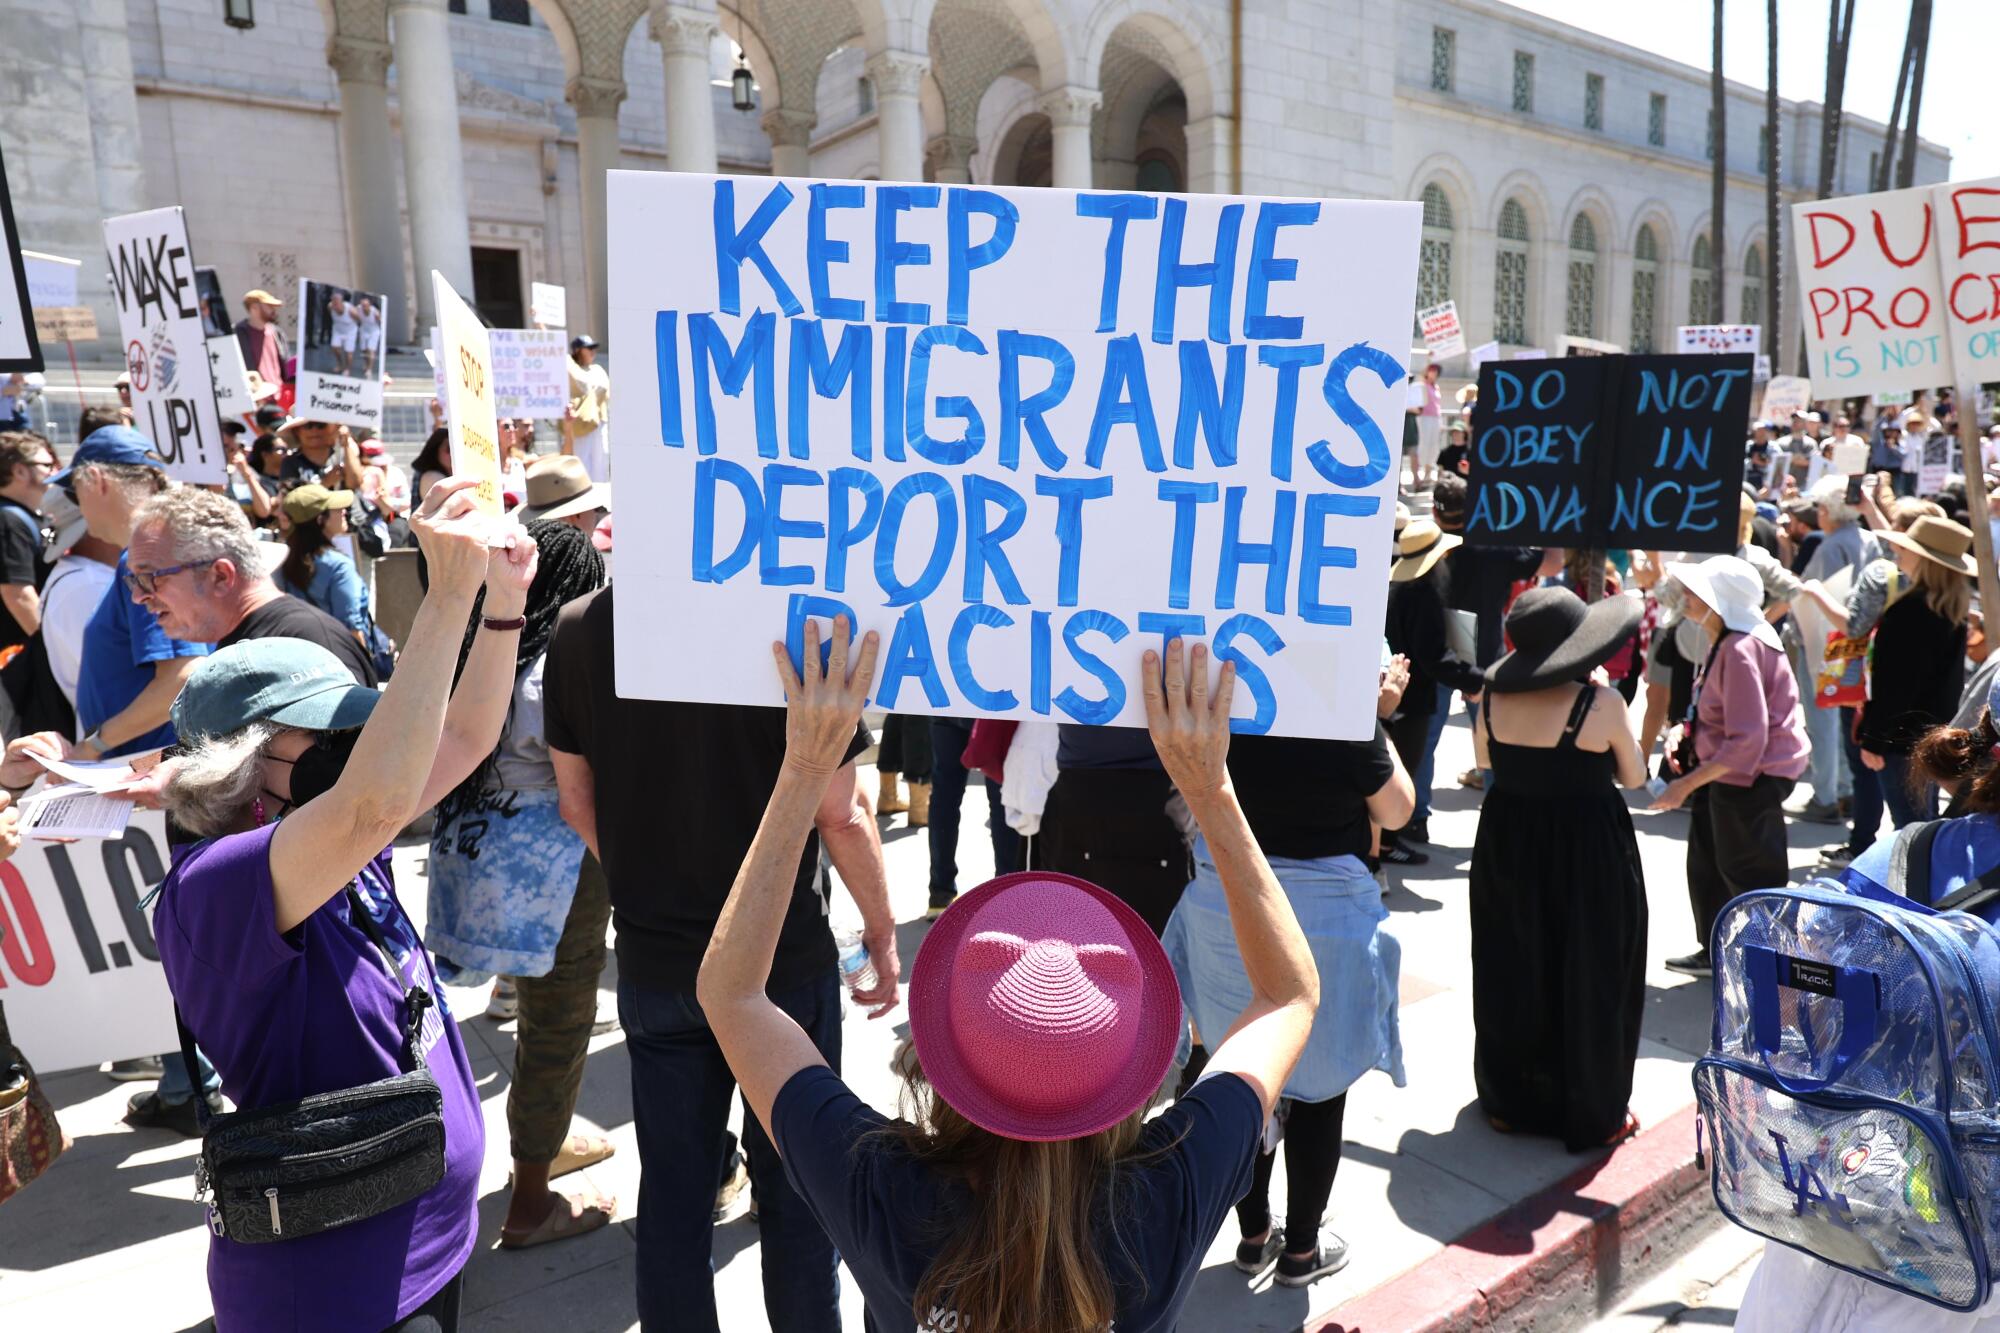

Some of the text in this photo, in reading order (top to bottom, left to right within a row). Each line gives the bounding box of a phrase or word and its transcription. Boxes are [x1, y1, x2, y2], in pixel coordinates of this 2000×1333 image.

[713, 178, 1321, 345] KEEP THE
[1802, 187, 2000, 270] DUE
[108, 234, 198, 328] WAKE
[318, 377, 361, 394] Demand
[460, 344, 484, 400] STOP
[1494, 369, 1566, 413] DO
[1637, 368, 1750, 415] NOT
[1824, 346, 1861, 379] IS
[1880, 335, 1941, 371] NOT
[147, 398, 207, 466] UP!
[310, 394, 378, 420] Prisoner Swap
[655, 307, 1406, 490] IMMIGRANTS
[1478, 421, 1712, 471] OBEY IN
[691, 457, 1381, 627] DEPORT THE
[0, 859, 56, 988] O
[1768, 1129, 1853, 1233] LA
